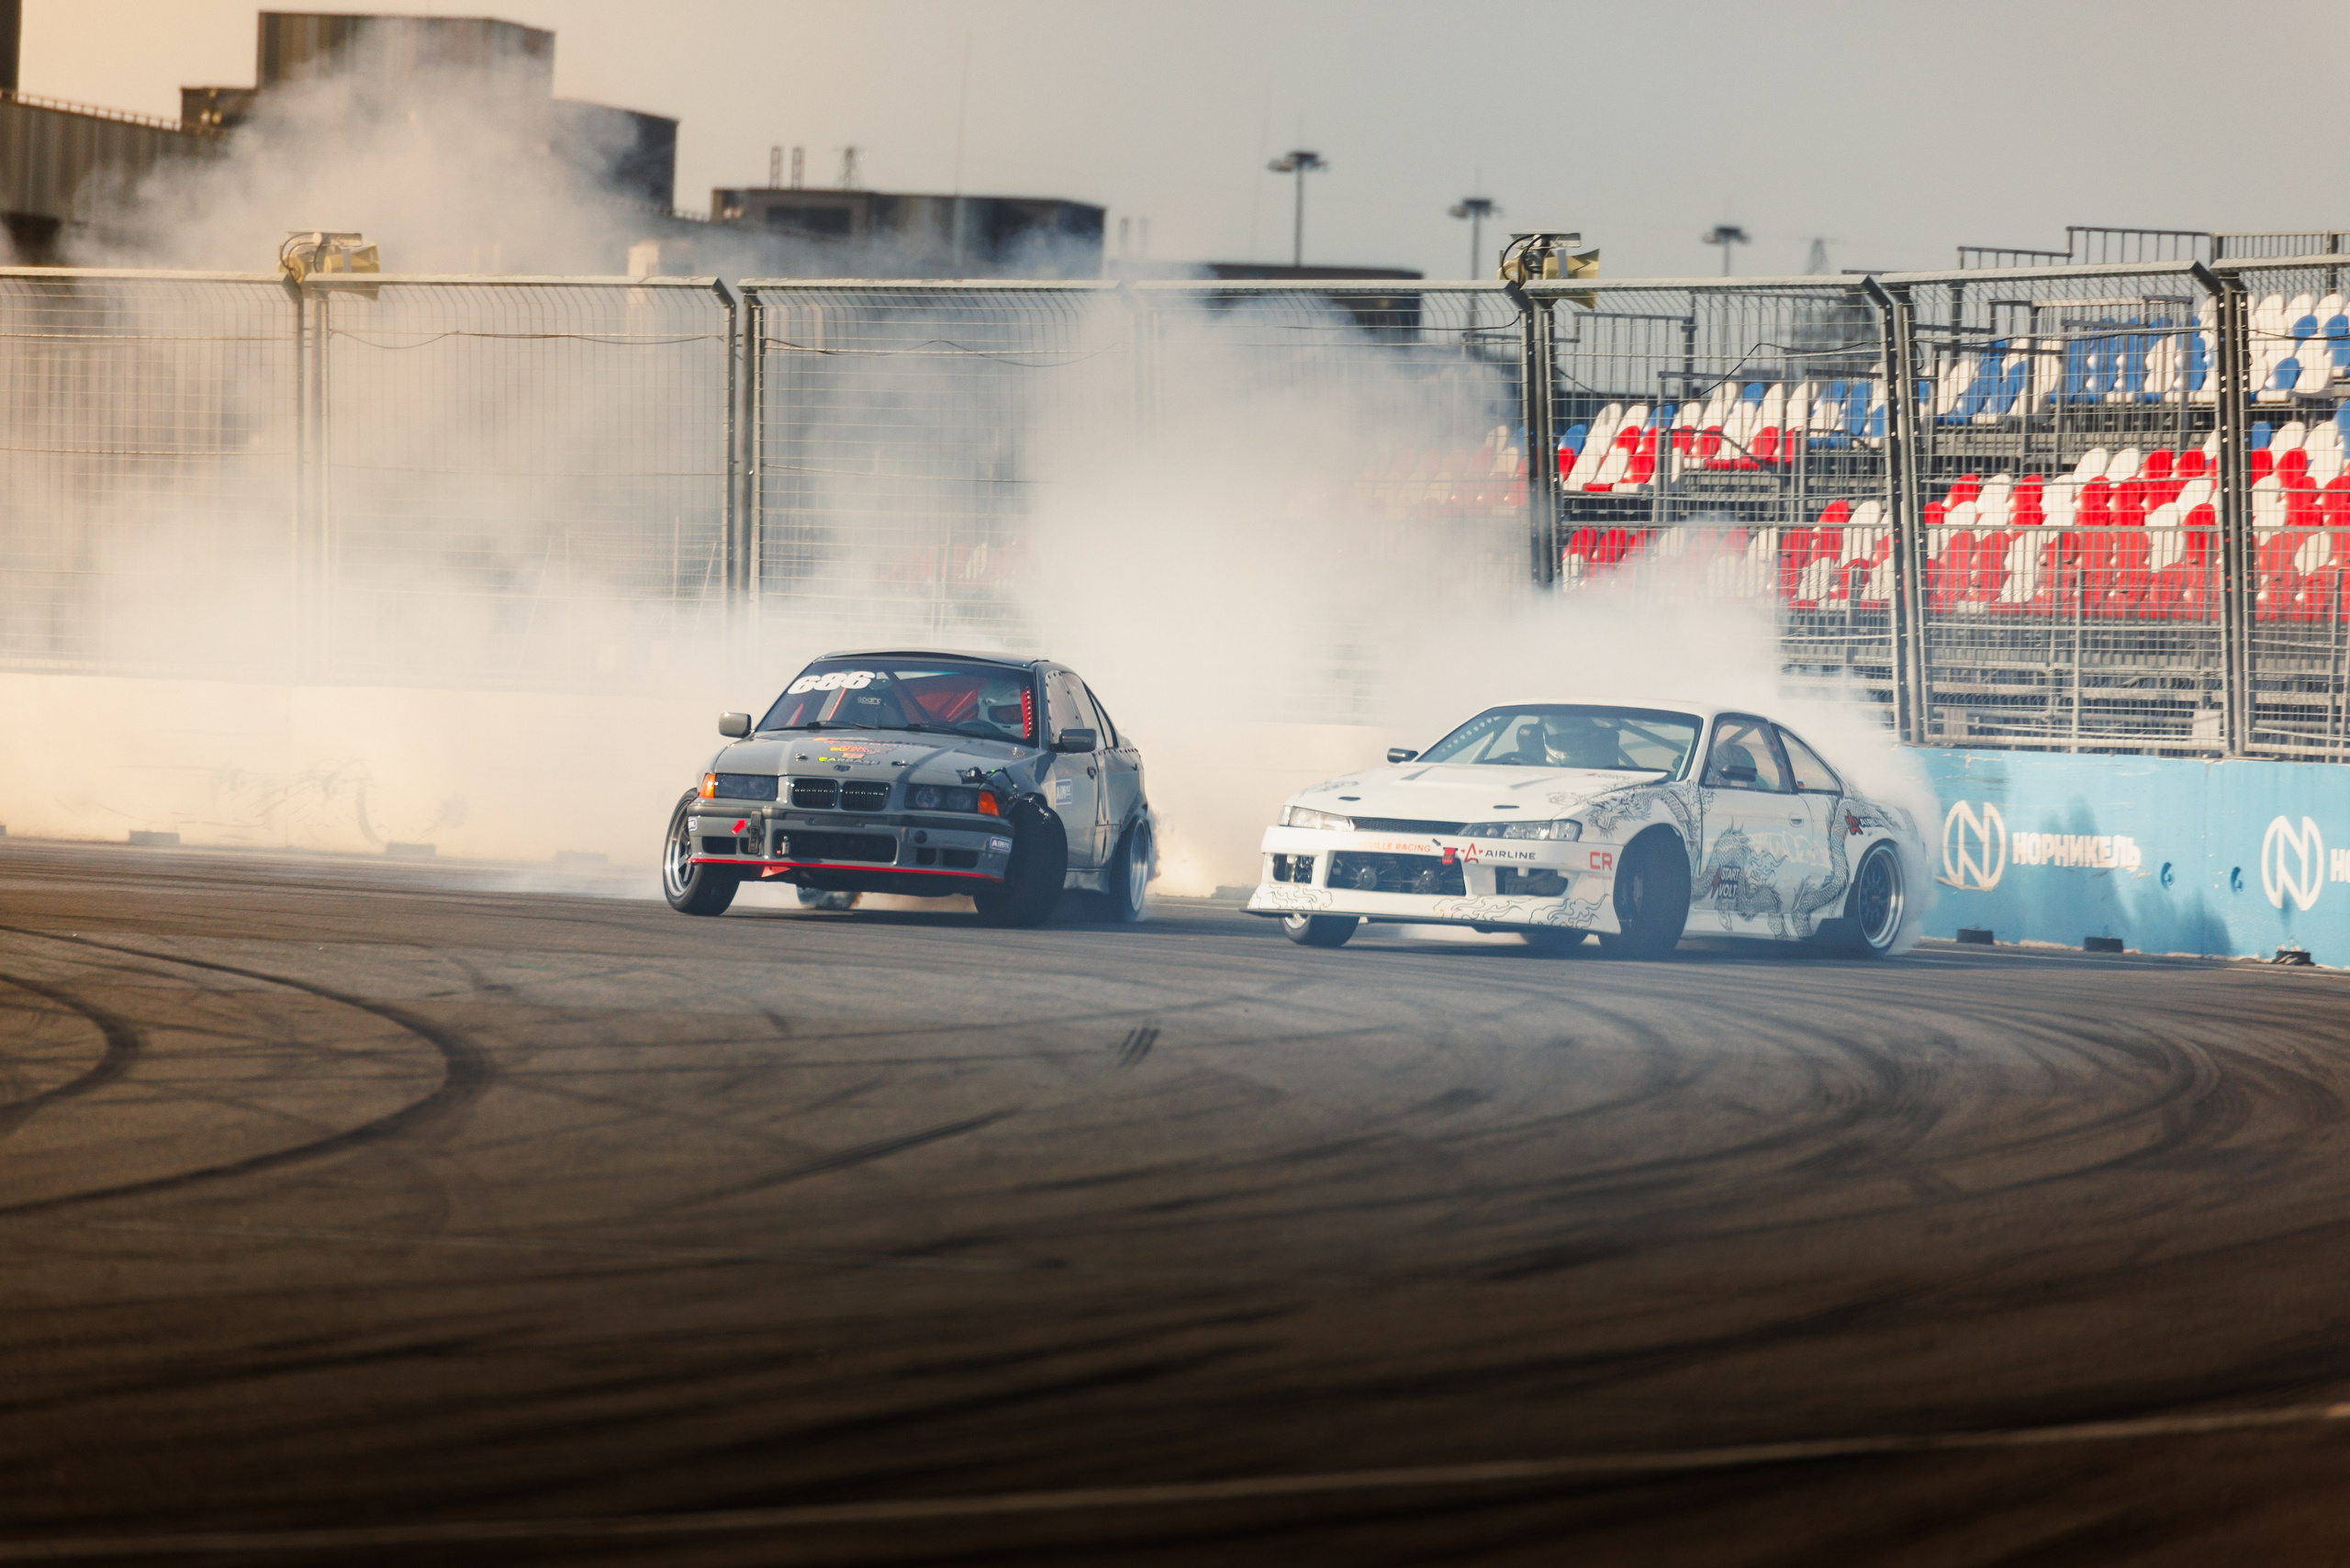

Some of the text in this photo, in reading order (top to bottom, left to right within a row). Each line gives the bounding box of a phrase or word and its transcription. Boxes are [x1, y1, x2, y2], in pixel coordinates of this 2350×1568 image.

[787, 671, 876, 695] 686
[1394, 843, 1431, 853] RACING
[1485, 849, 1536, 860] AIRLINE
[2011, 832, 2142, 873] НОРНИКЕЛЬ
[1589, 851, 1613, 871] CR
[1720, 867, 1740, 881] START
[1718, 883, 1738, 898] VOLT
